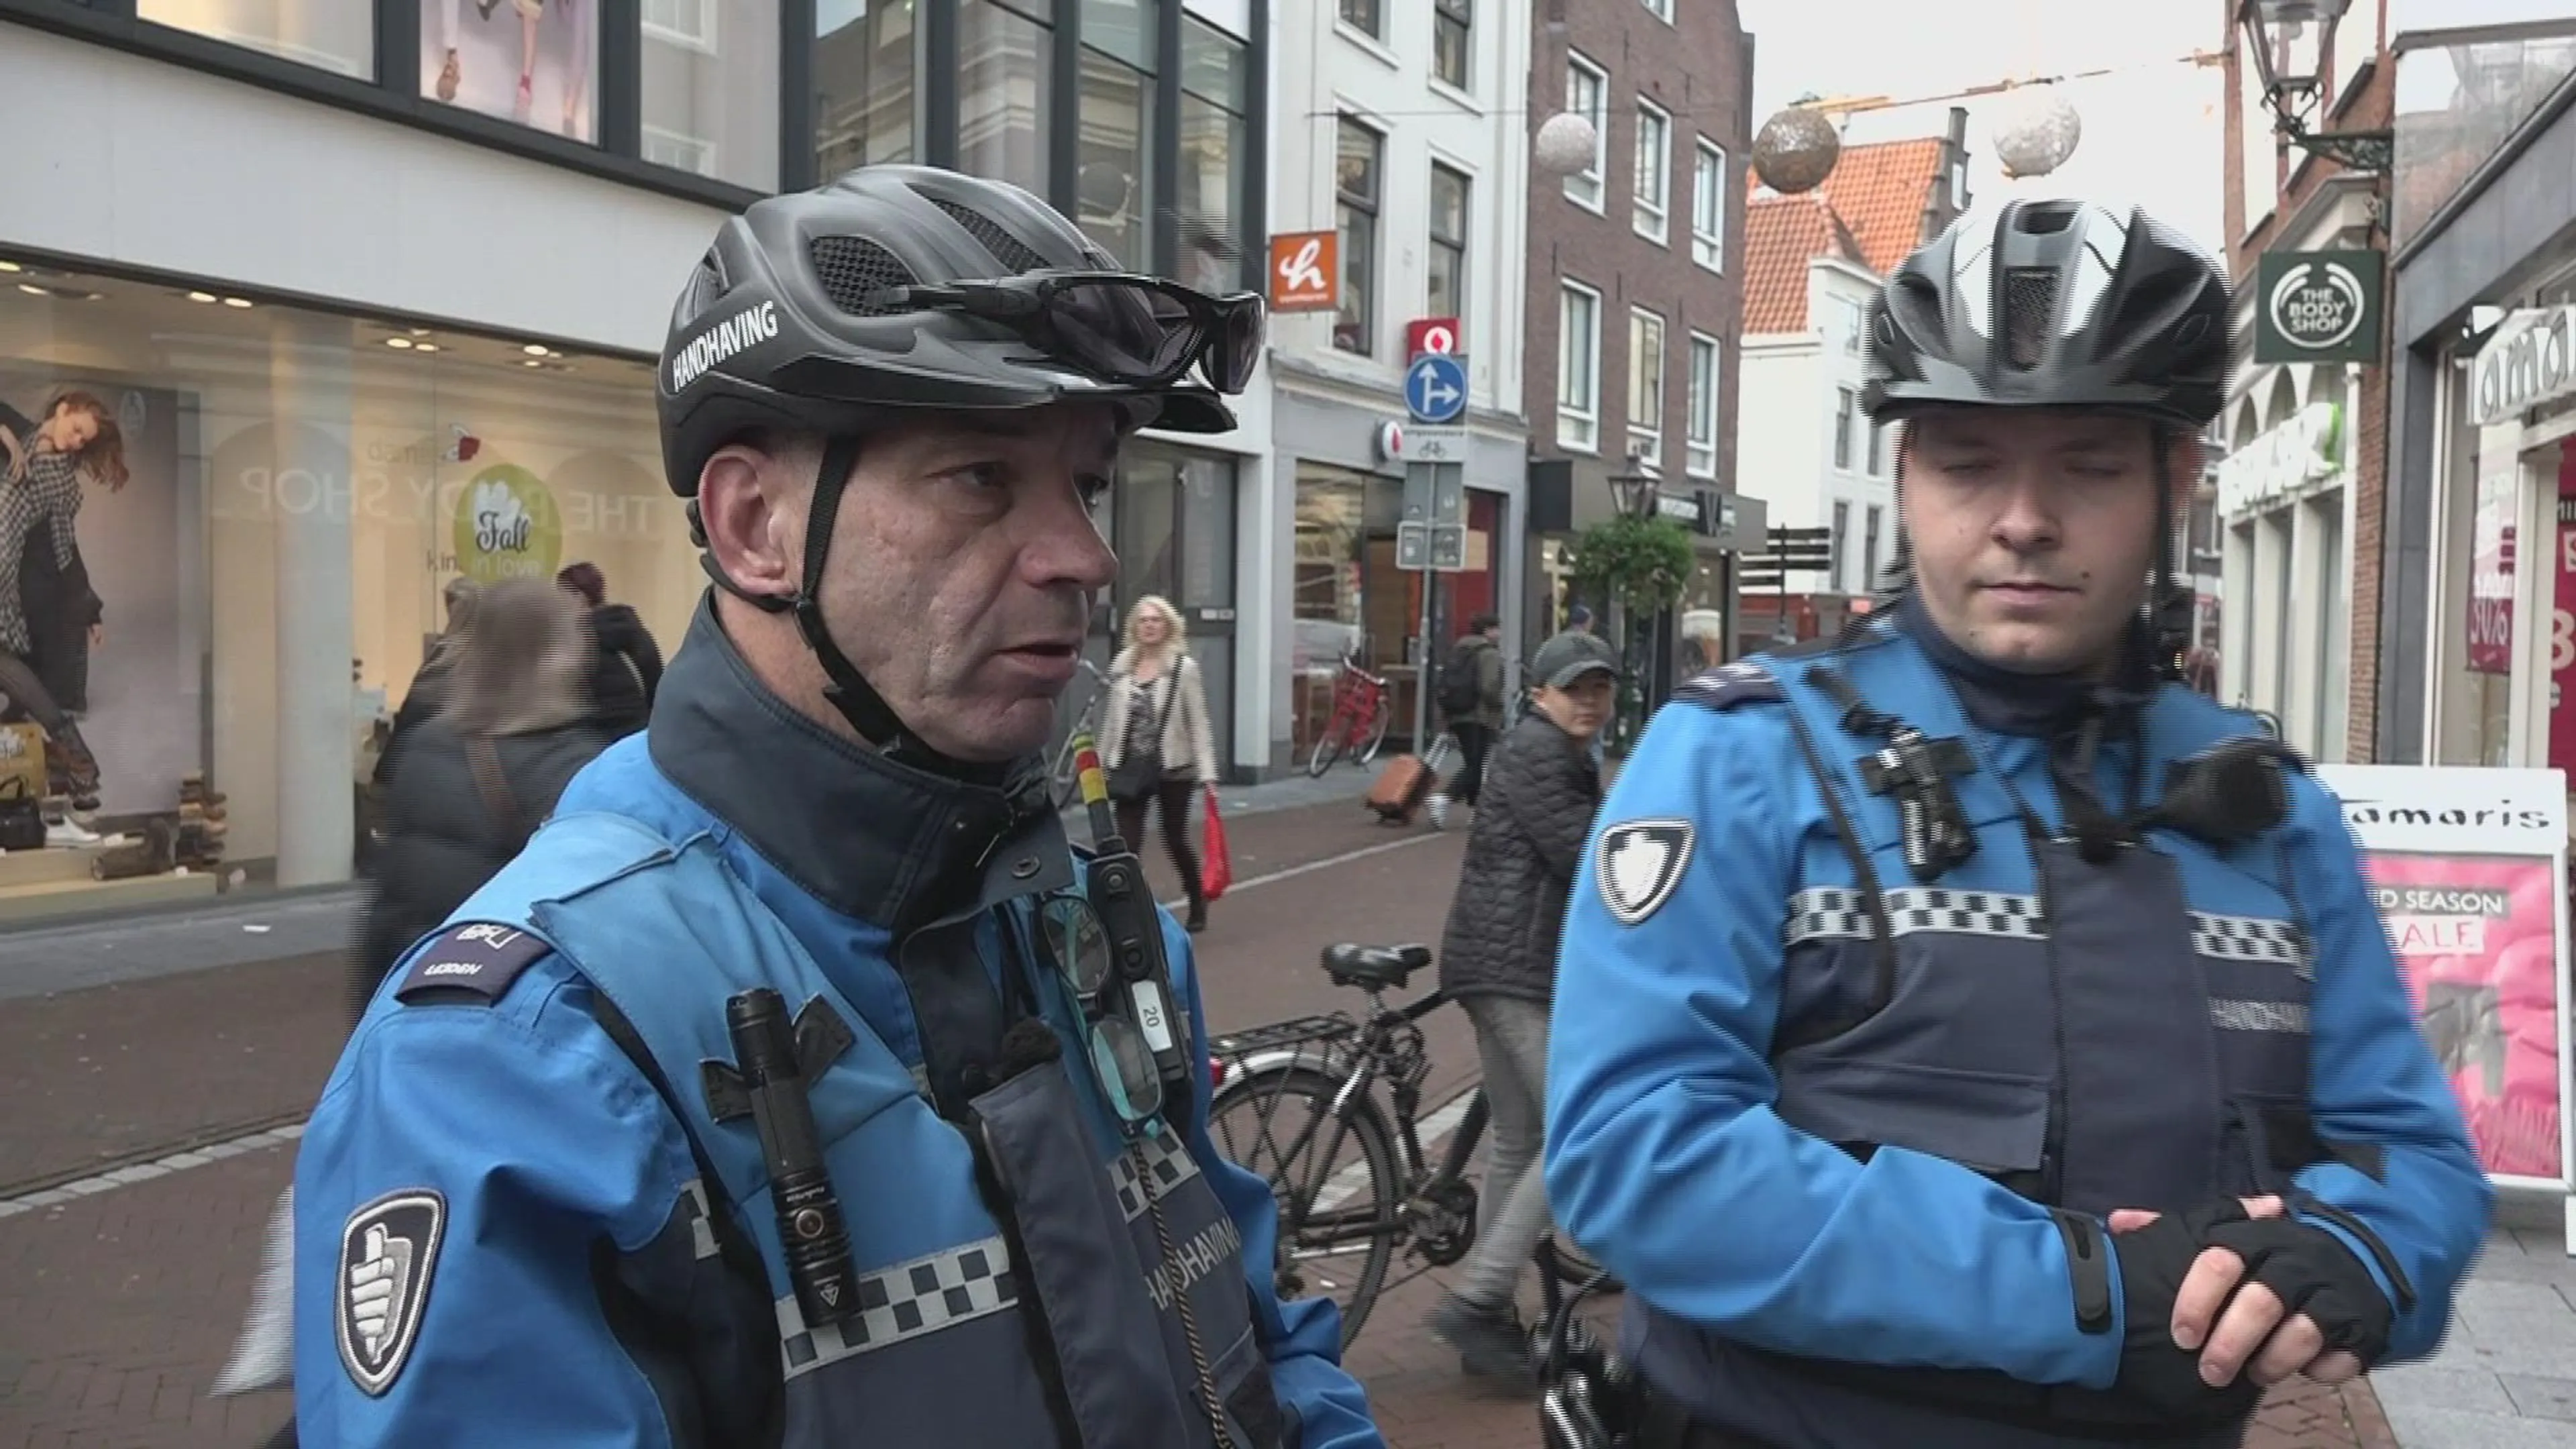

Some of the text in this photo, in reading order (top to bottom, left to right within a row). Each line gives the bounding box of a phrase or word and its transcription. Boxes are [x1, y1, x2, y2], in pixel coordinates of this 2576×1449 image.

[2301, 288, 2333, 302] THE
[2289, 301, 2346, 317] BODY
[2292, 317, 2343, 333] SHOP
[673, 300, 778, 393] HANDHAVING
[476, 511, 530, 554] Fall
[2341, 799, 2550, 828] amaris
[2405, 890, 2503, 913] SEASON
[2400, 922, 2478, 947] ALE
[1142, 1006, 1161, 1028] 20
